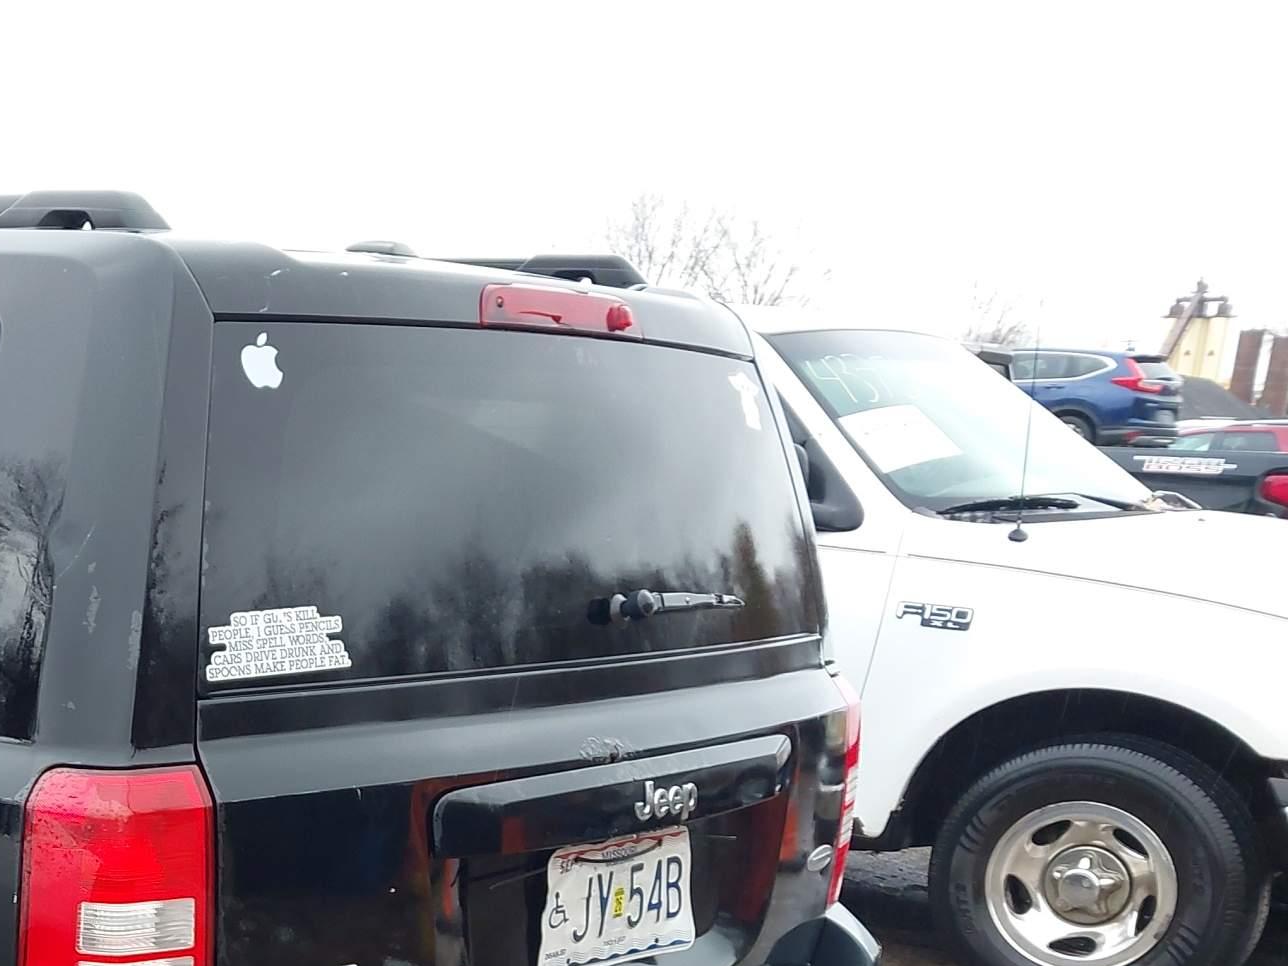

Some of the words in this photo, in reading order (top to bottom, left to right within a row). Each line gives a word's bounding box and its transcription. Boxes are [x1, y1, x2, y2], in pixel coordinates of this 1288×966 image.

[211, 628, 255, 642] PEOPLE,
[263, 624, 297, 637] GUESS
[299, 619, 340, 633] PENCILS
[232, 615, 248, 628] SO
[250, 614, 261, 626] IF
[263, 611, 294, 625] GUS
[296, 609, 318, 621] KILL
[929, 620, 960, 629] XL
[213, 653, 243, 667] CARS
[245, 649, 278, 663] DRIVE
[280, 645, 317, 660] DRUNK
[319, 642, 343, 655] AND
[228, 640, 254, 652] MISS
[256, 637, 286, 650] SPELL
[208, 665, 251, 679] SPOONS
[254, 661, 287, 675] MAKE
[289, 656, 327, 671] PEOPLE
[328, 654, 349, 667] FAT.
[634, 780, 698, 822] Jeep
[572, 870, 614, 943] JY
[627, 855, 683, 929] 54B
